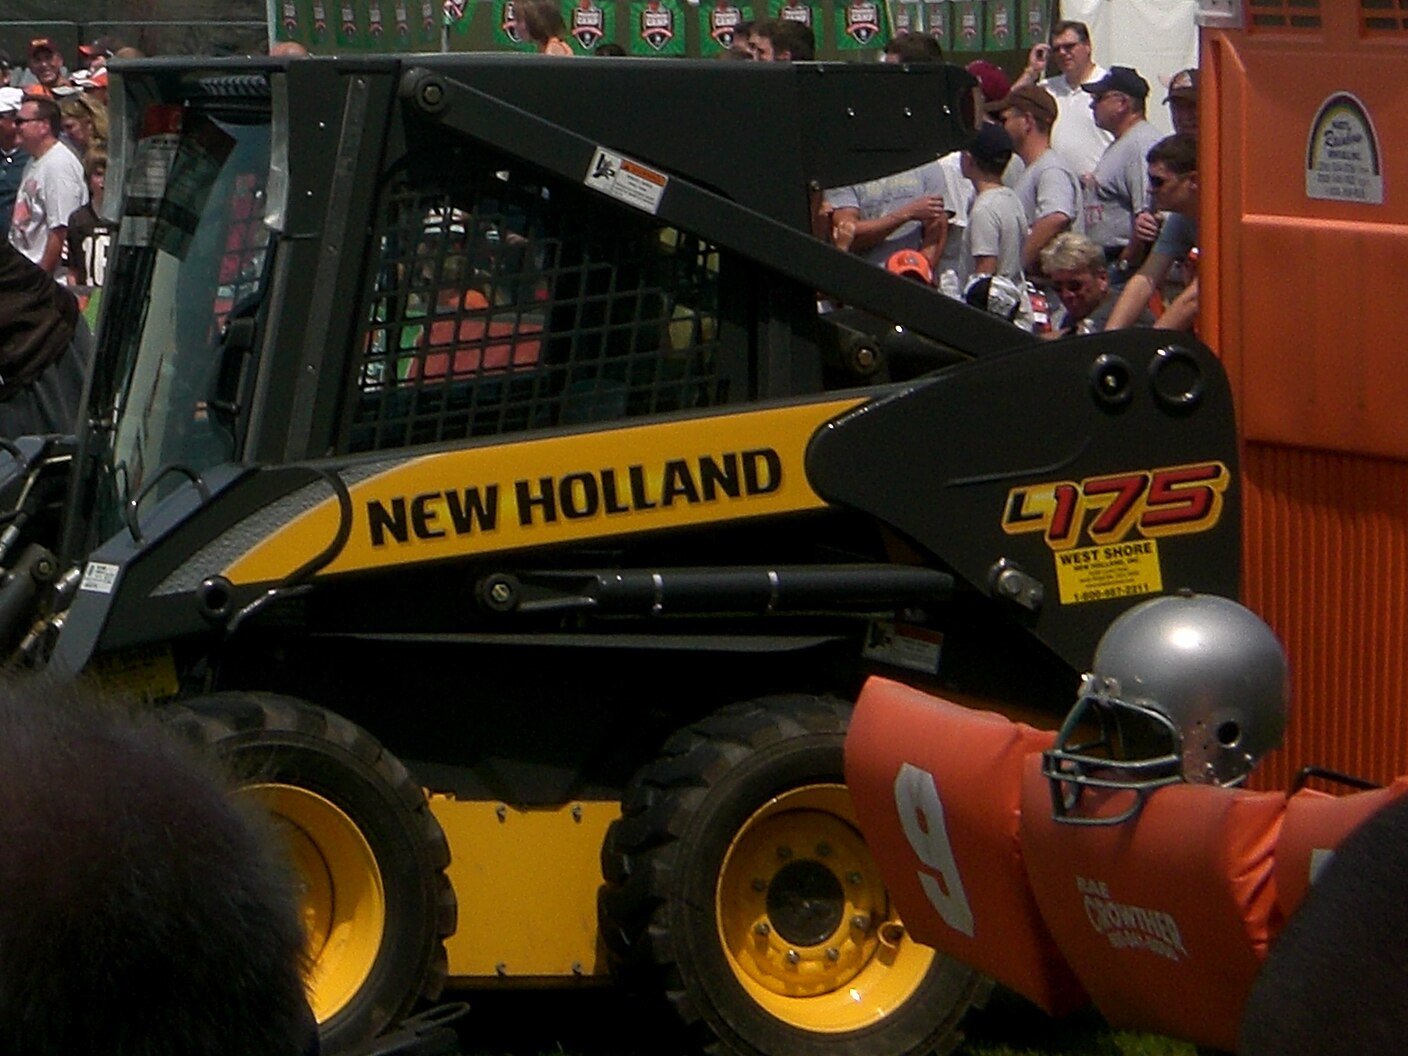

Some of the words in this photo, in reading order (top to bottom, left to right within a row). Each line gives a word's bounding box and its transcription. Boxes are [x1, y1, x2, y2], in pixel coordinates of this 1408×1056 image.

[365, 485, 499, 546] NEW
[513, 447, 785, 528] HOLLAND
[1002, 462, 1230, 550] L175
[1060, 549, 1099, 565] WEST
[1103, 541, 1153, 559] SHORE
[894, 761, 975, 938] 9
